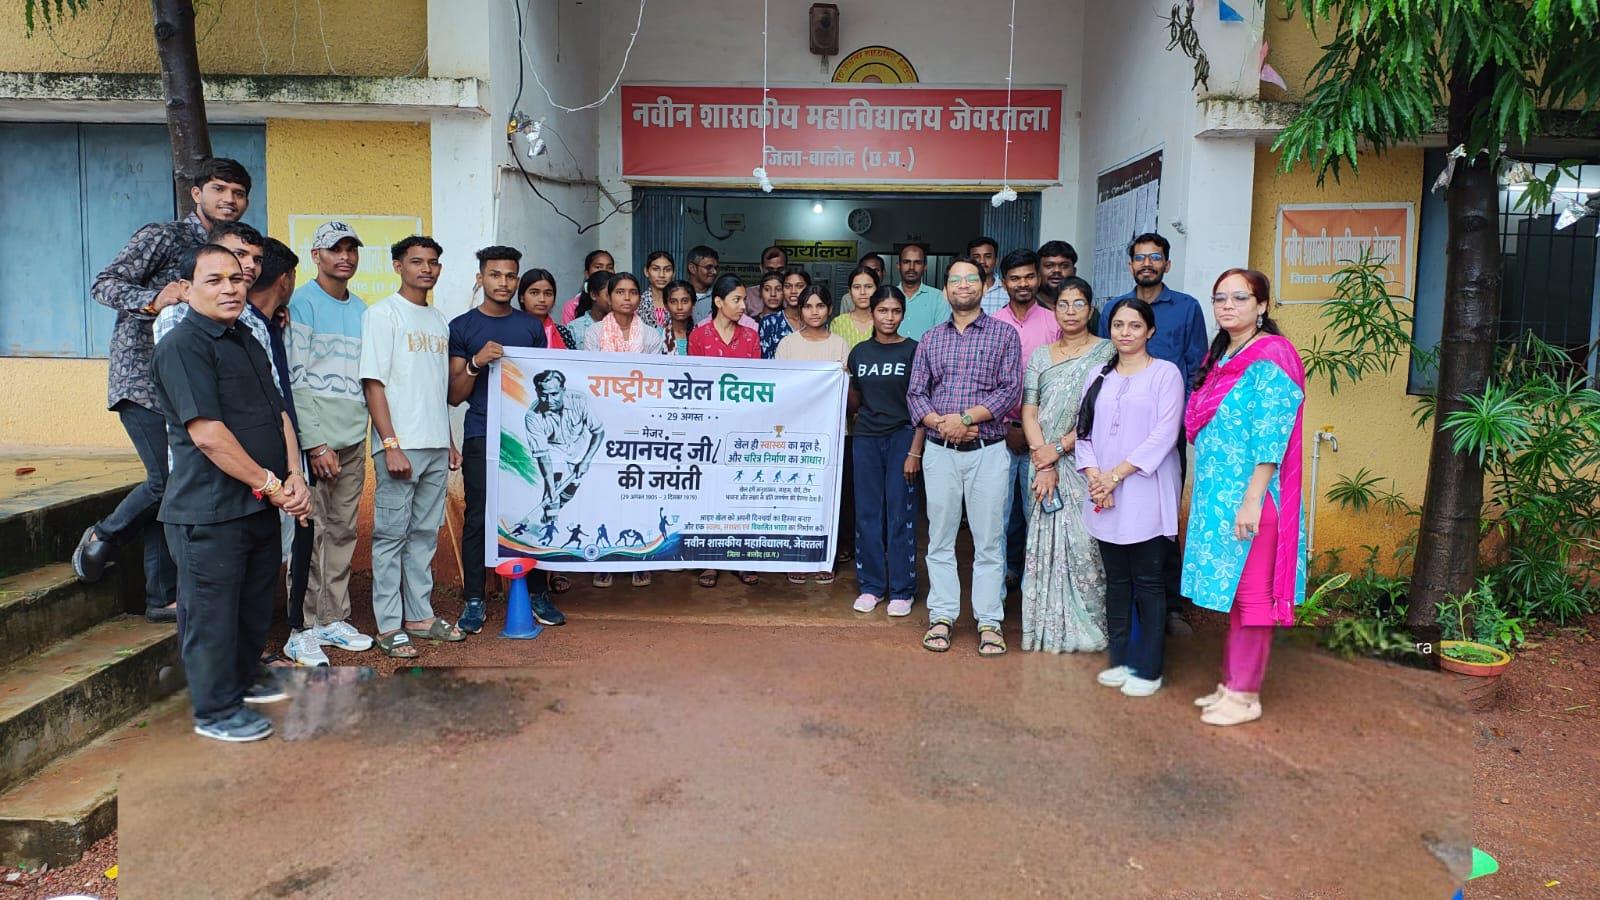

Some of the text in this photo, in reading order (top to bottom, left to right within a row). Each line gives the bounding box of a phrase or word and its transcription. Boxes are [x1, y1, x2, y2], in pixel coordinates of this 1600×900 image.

[632, 96, 1051, 132] नवीन शासकीय महाविद्यालय जेवरतला
[861, 146, 915, 172] (छ.ग.)
[857, 362, 906, 377] BABE
[588, 370, 776, 403] राष्ट्रीय खेल दिवस
[667, 412, 704, 422] 29 अगस्त
[642, 425, 664, 438] मेजर
[606, 435, 713, 462] ध्यानचंद जी
[734, 438, 749, 449] खेल
[751, 438, 759, 450] ही
[788, 441, 798, 450] का
[800, 441, 812, 453] मूल
[728, 451, 742, 463] और
[744, 452, 761, 463] चरित्र
[763, 452, 786, 463] निर्माण
[788, 454, 798, 463] का
[618, 463, 702, 490] की जयंती
[684, 536, 824, 549] नवीन शासकीय महाविद्यालय, जेवरतला
